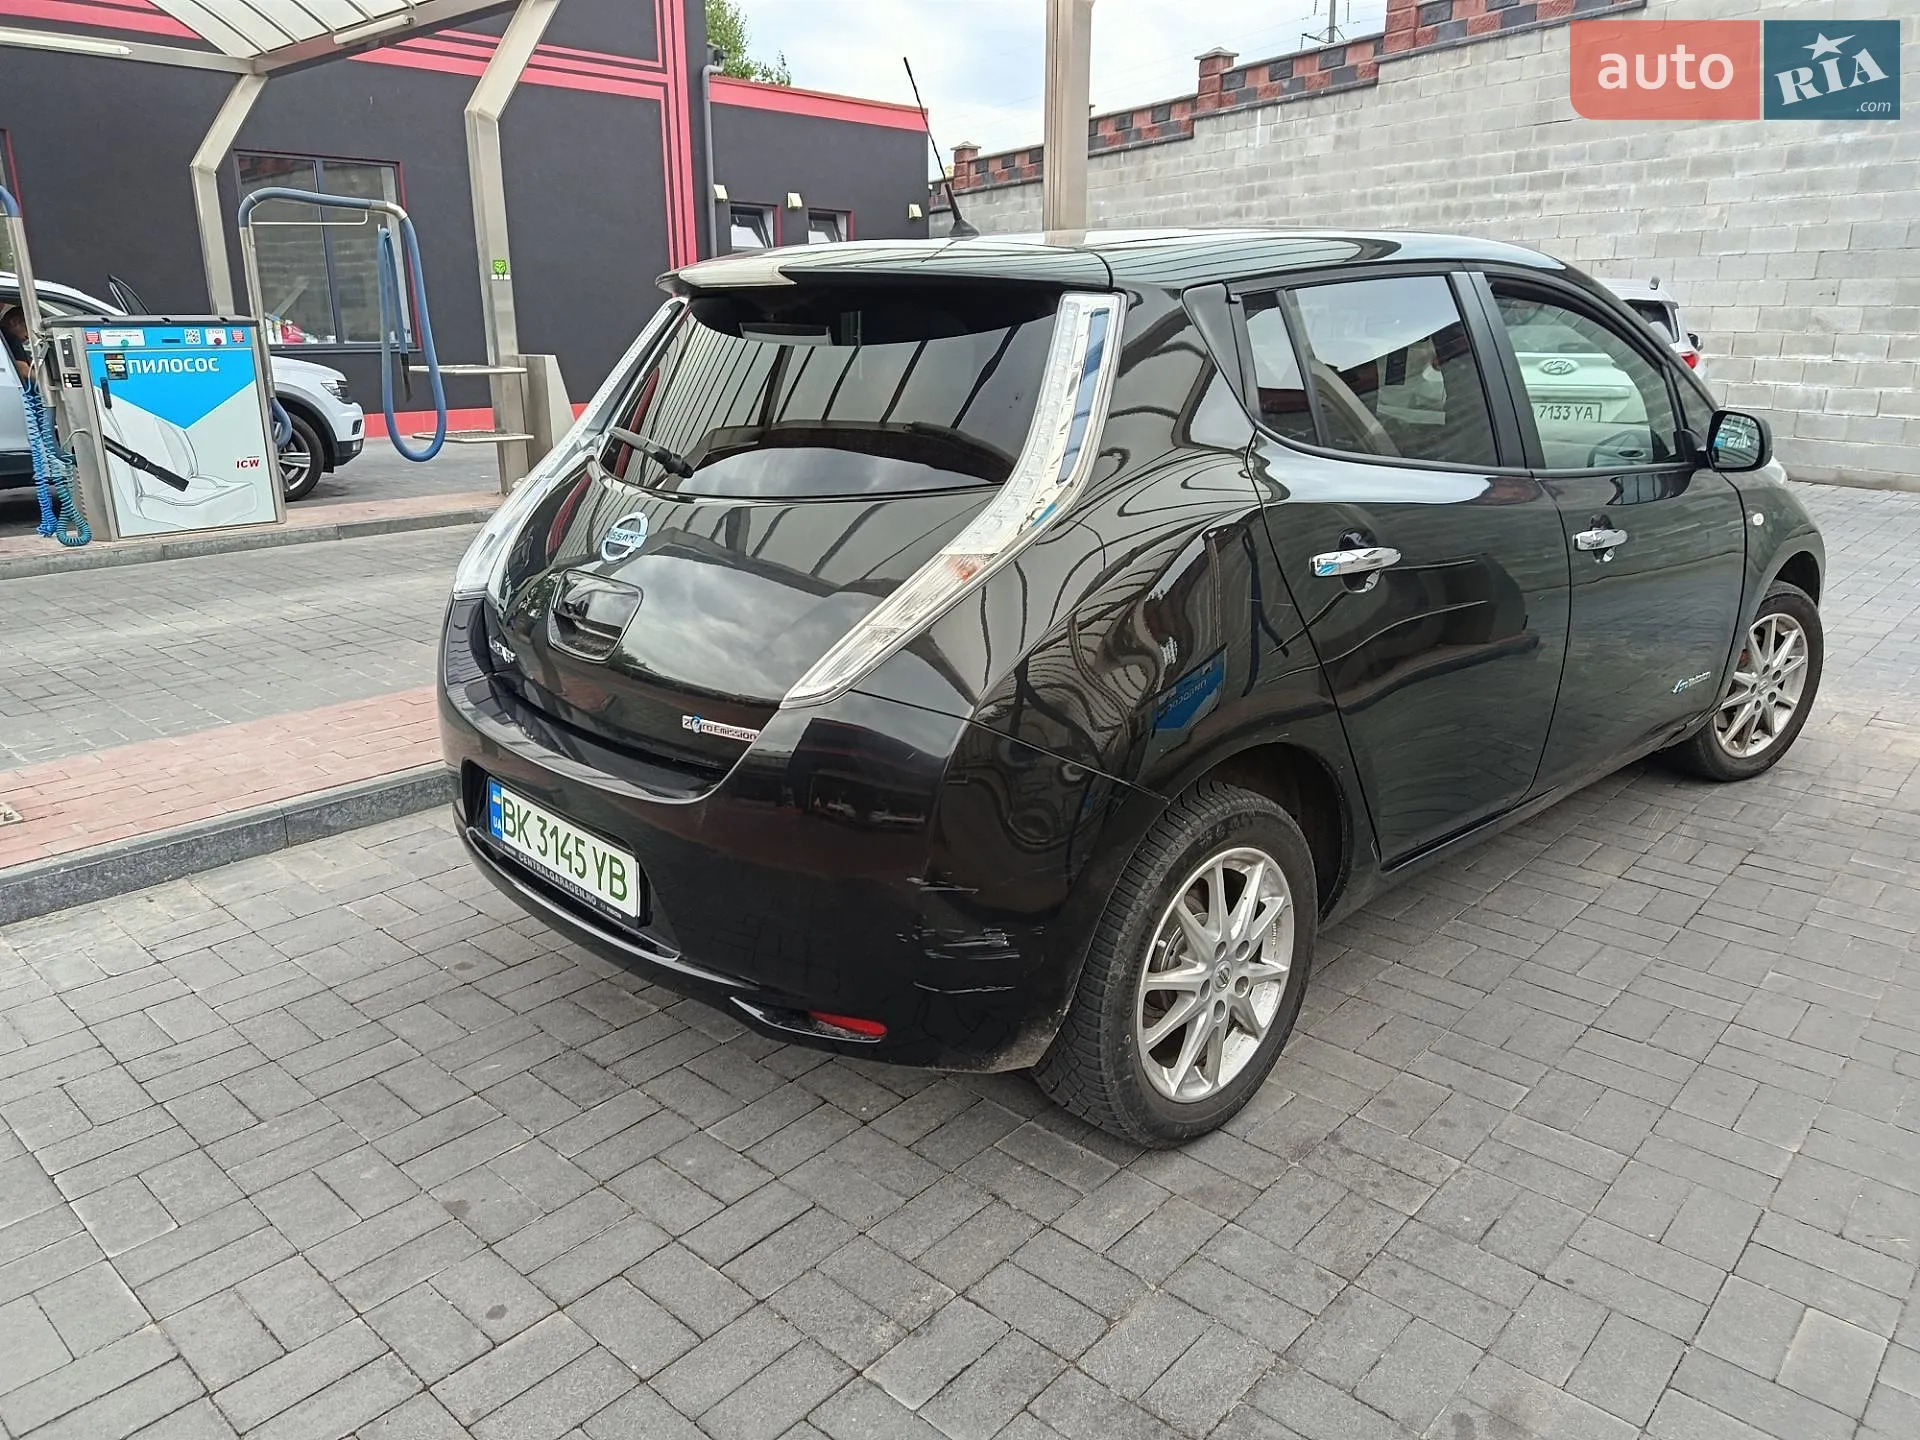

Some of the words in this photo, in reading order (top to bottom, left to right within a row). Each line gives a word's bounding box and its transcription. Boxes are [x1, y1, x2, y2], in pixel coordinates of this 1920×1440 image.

[128, 357, 220, 375] ПИЛОСОС
[1539, 405, 1572, 421] 7133
[1575, 405, 1593, 420] YA
[236, 459, 260, 469] ICW
[492, 815, 502, 831] UA
[502, 796, 532, 850] BK
[536, 815, 587, 880] 3145
[592, 845, 628, 902] YB
